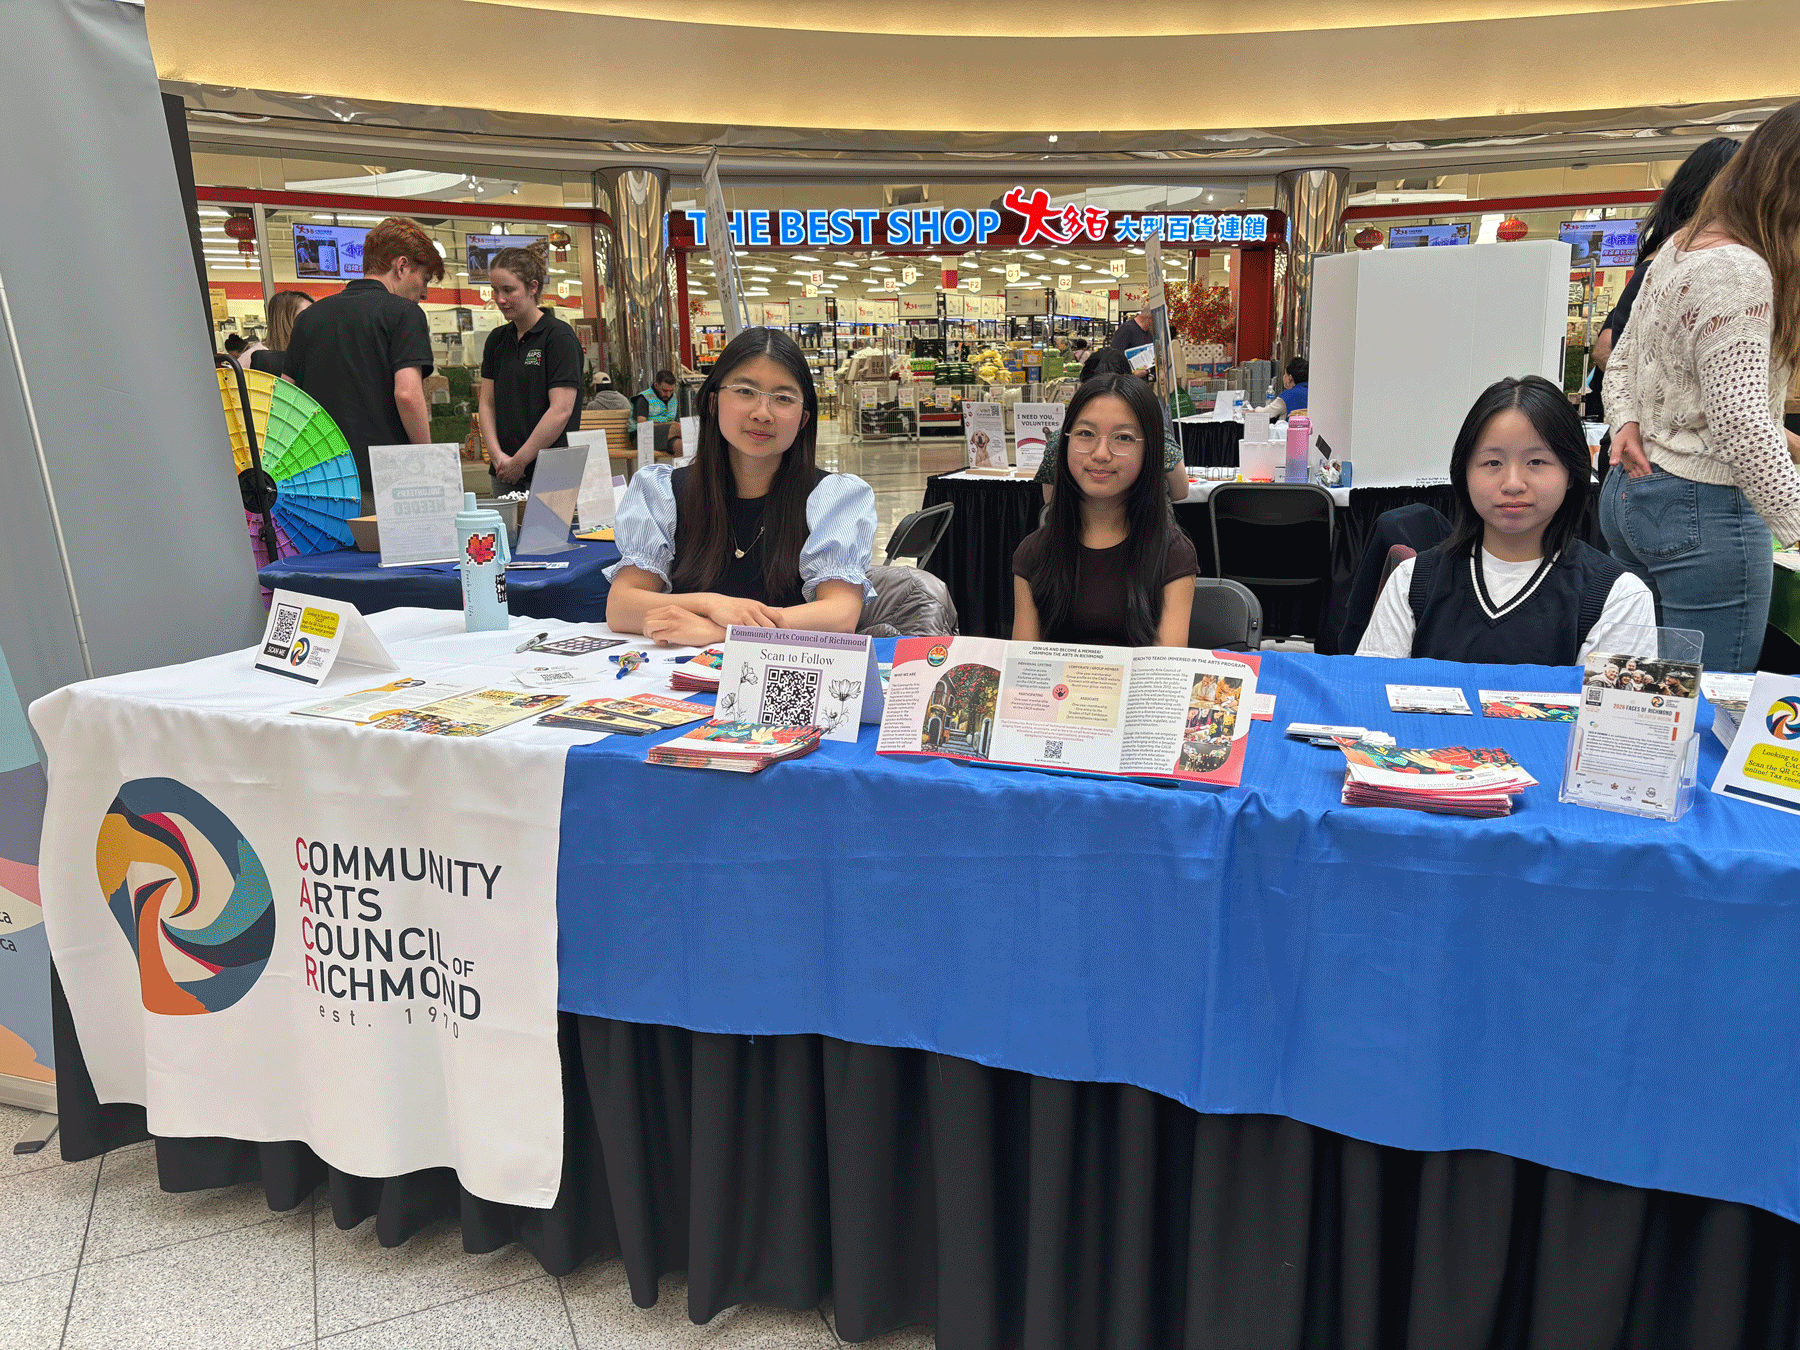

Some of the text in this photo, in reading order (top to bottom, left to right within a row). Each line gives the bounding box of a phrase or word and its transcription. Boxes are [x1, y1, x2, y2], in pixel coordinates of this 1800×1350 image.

[686, 209, 1001, 246] THE BEST SHOP
[1114, 214, 1269, 243] 大型百貨連鎖
[906, 272, 914, 280] F1
[1112, 264, 1124, 273] H1
[812, 274, 822, 282] E1
[559, 286, 568, 294] B1
[731, 629, 773, 640] Community
[790, 633, 818, 643] Council
[820, 635, 828, 644] of
[829, 636, 867, 647] Richmond
[268, 646, 286, 656] SCAN ME
[760, 649, 835, 665] Scan to Follow
[1648, 707, 1672, 716] RICHMOND
[1762, 749, 1790, 761] Looking
[1748, 760, 1765, 768] Scan
[1745, 767, 1768, 776] online!
[1784, 776, 1800, 784] rece
[296, 836, 502, 900] COMMUNITY
[300, 877, 382, 922] ARTS
[302, 916, 474, 978] COUNCIL OF
[305, 954, 481, 1020] RICHMOND
[319, 1004, 459, 1039] est. 1970
